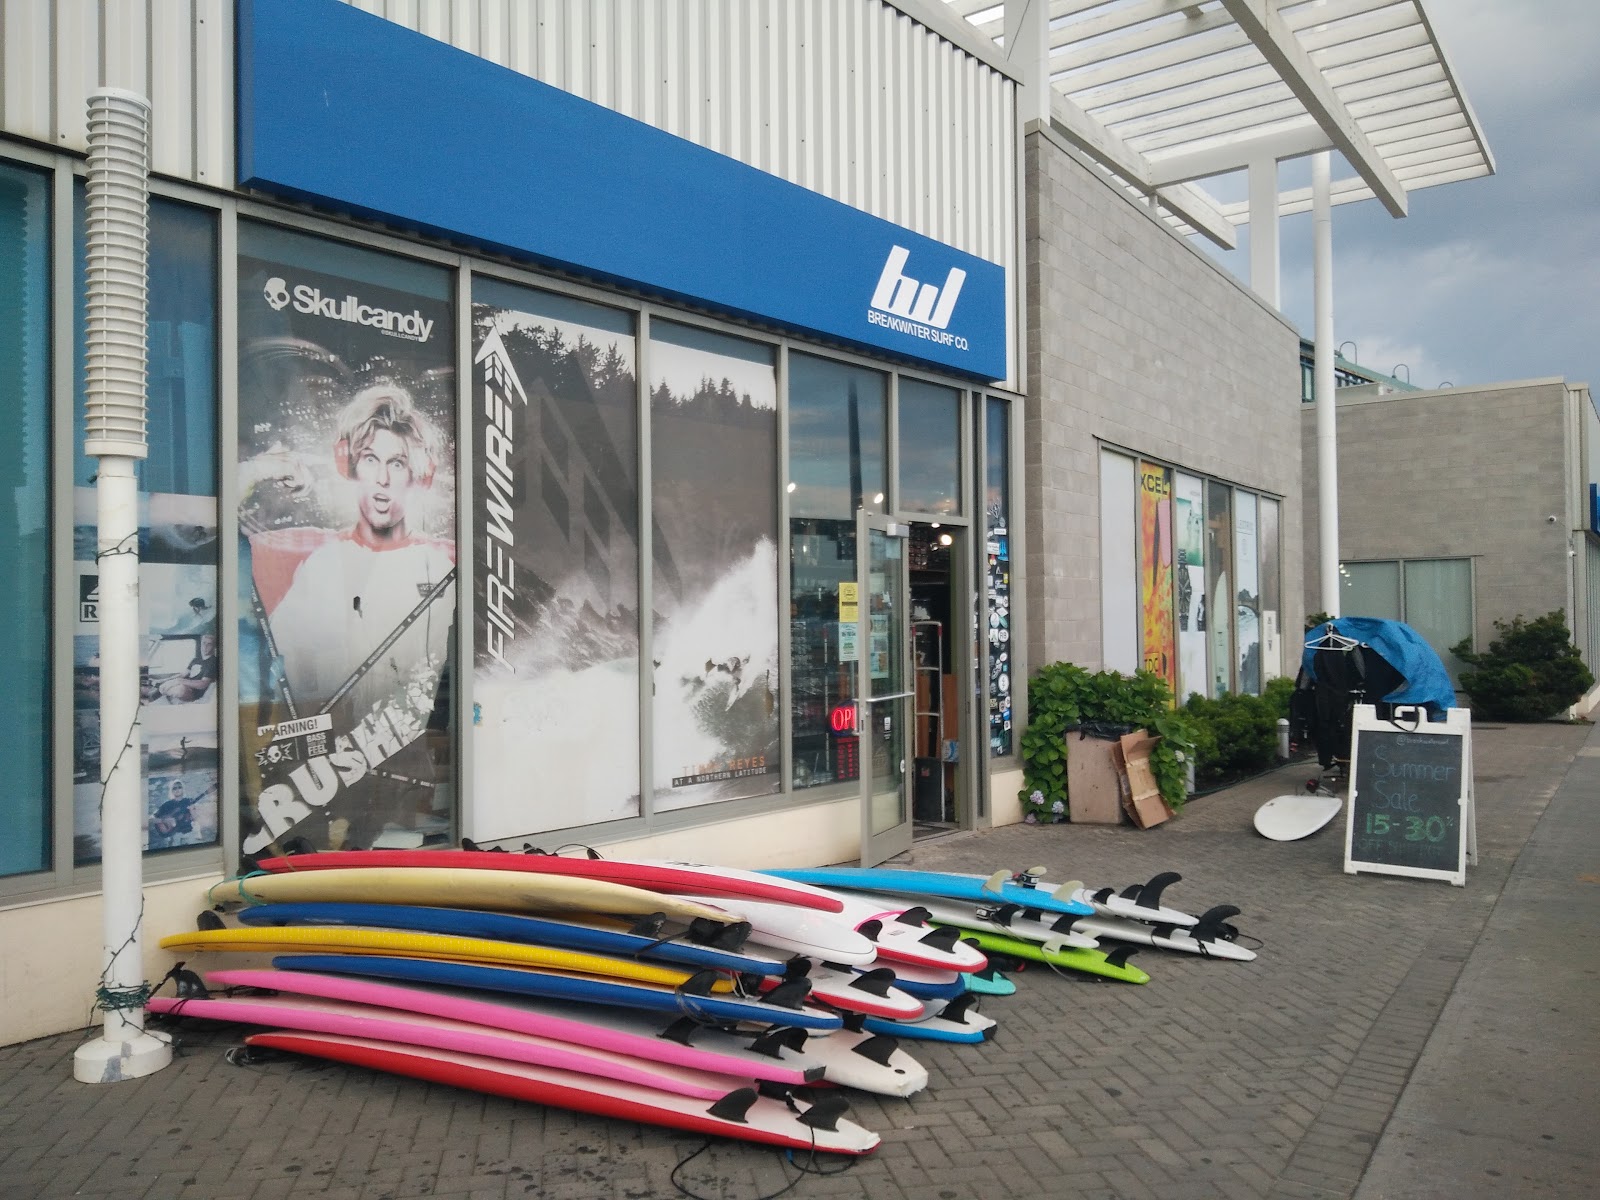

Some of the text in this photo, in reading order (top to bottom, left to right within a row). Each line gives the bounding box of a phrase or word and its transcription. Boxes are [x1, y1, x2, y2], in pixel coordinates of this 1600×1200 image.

[293, 285, 434, 343] Skullcandy
[867, 309, 930, 341] BREAKWATER
[931, 329, 954, 346] SURF
[483, 350, 517, 674] FIREWIRE
[674, 778, 684, 786] AT
[696, 771, 731, 783] NORTHERN
[734, 766, 767, 778] LATITUDE
[730, 756, 765, 770] REYES
[1372, 744, 1456, 781] Summer
[1373, 780, 1421, 812] Sale
